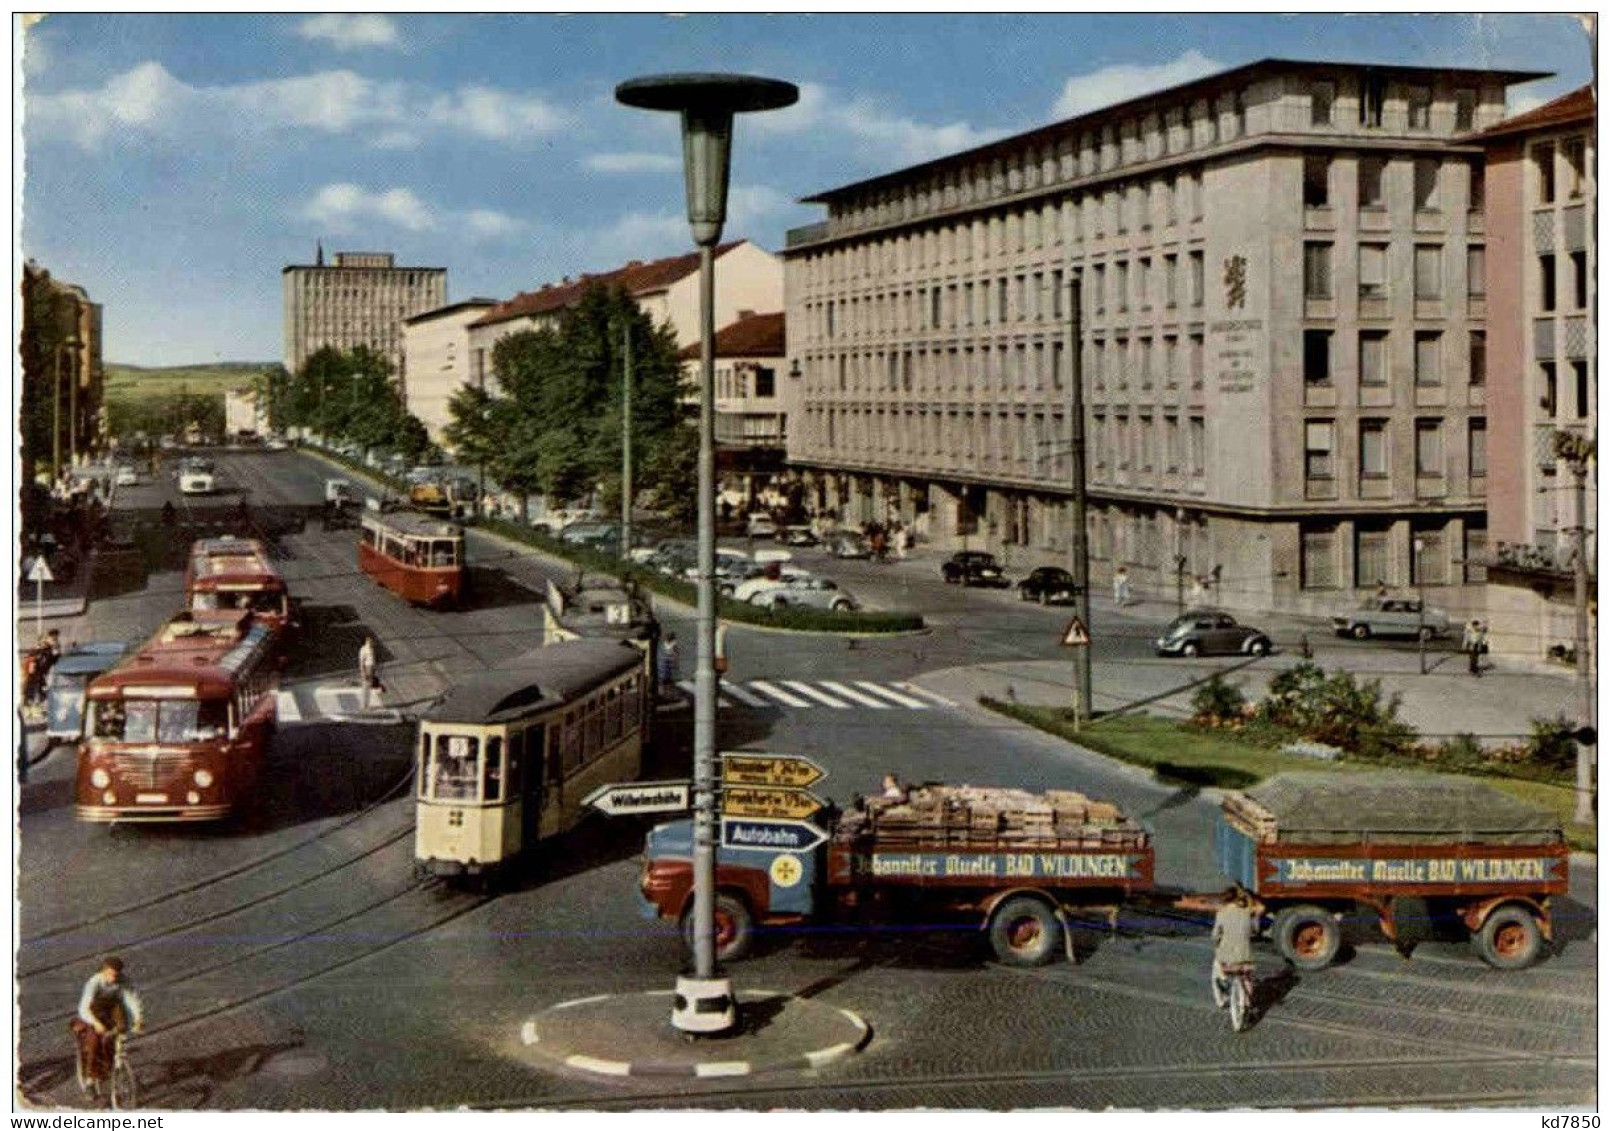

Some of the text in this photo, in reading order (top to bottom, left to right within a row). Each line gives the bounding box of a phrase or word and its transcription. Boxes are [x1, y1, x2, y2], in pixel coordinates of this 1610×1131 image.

[732, 825, 799, 845] Autobahn
[1006, 854, 1034, 876] BAD
[1042, 853, 1126, 877] WILDUNGEN
[1428, 859, 1455, 881] BAD
[1462, 858, 1543, 880] WILDUNGEN
